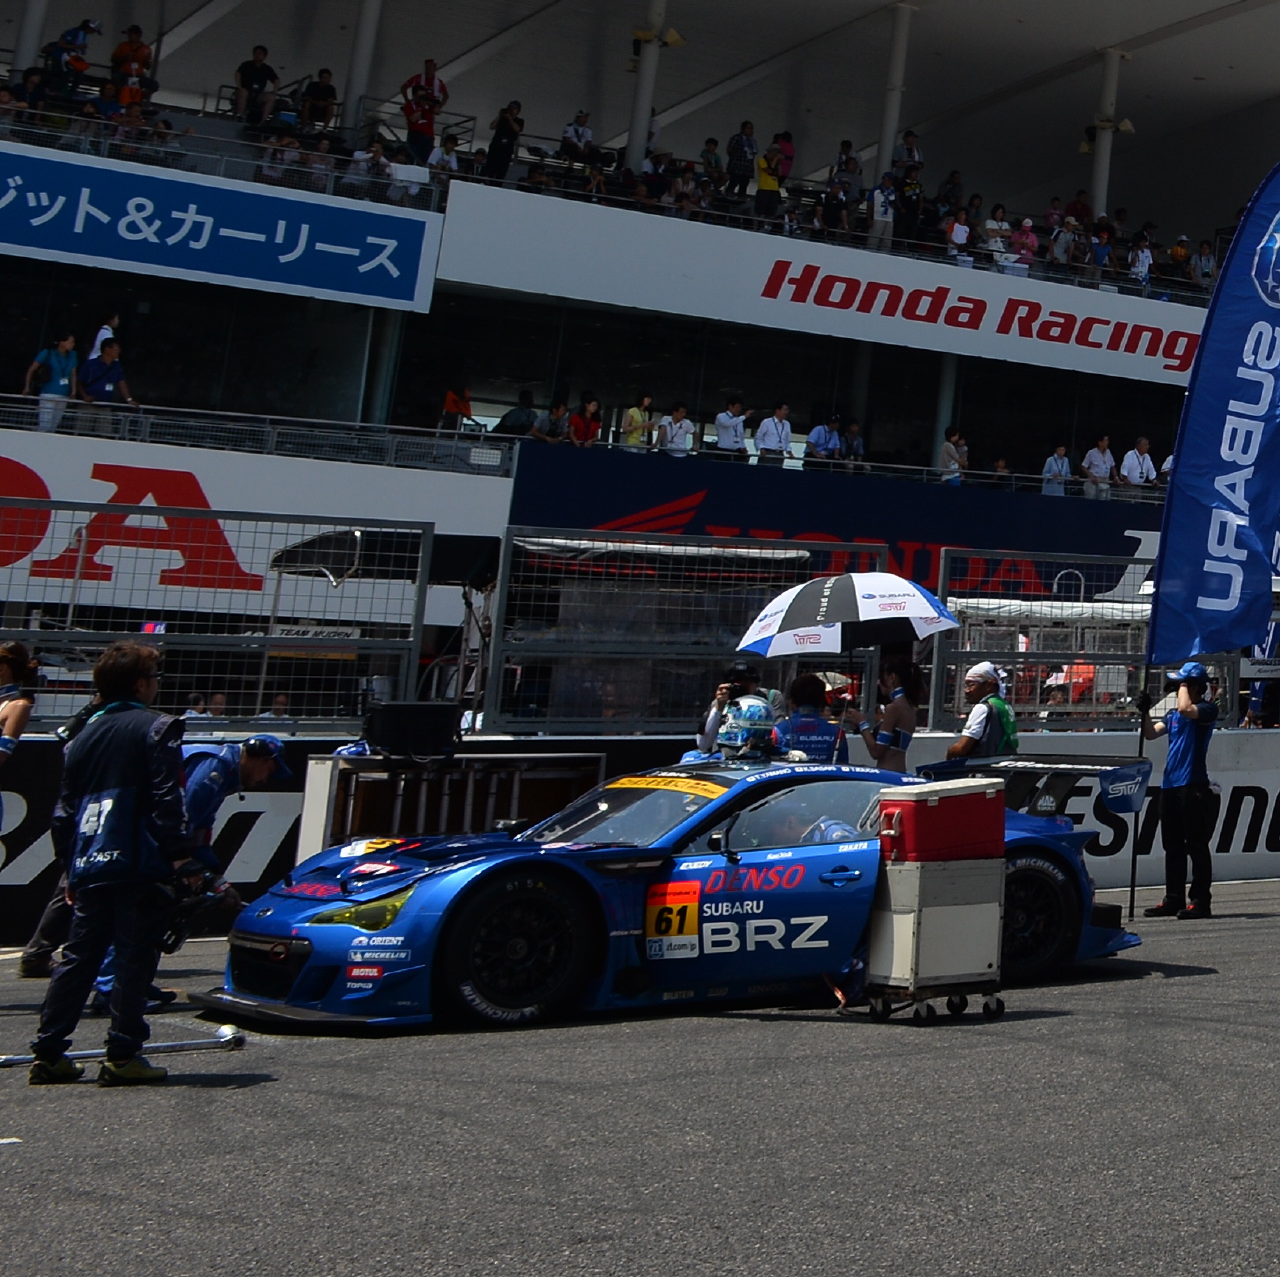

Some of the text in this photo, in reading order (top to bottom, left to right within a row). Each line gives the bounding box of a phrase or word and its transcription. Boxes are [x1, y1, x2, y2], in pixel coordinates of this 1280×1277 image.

[760, 259, 1200, 372] Honda Racing
[704, 863, 807, 894] DENSO
[1015, 858, 1066, 884] MICHELIN
[654, 904, 689, 936] 61
[702, 899, 764, 917] SUBARU
[369, 936, 405, 946] ORIENT
[702, 915, 830, 955] BRZ
[363, 951, 407, 959] MICHELIN
[351, 968, 379, 976] MOTUL
[462, 984, 521, 1021] MICHELIN
